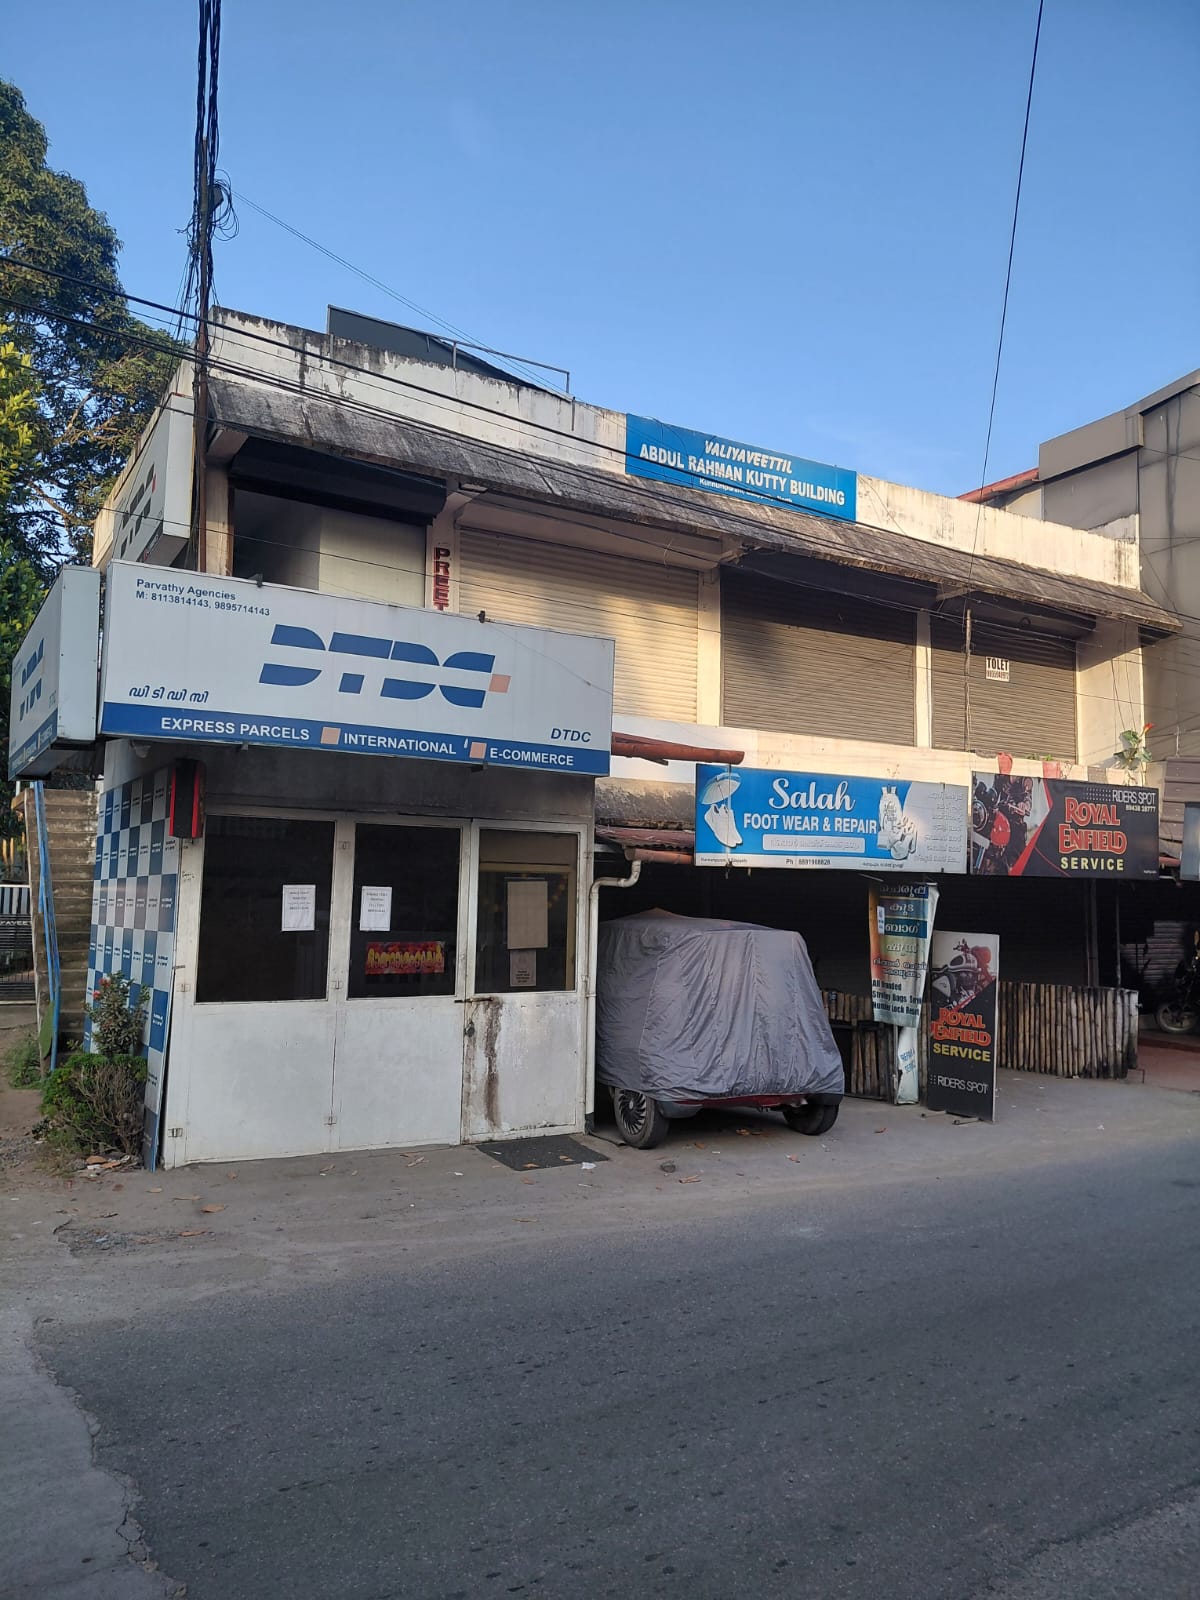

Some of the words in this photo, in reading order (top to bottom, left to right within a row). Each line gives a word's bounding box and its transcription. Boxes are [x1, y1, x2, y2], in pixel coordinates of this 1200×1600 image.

[705, 440, 792, 474] VALIYAVEETTIL
[639, 443, 684, 469] ABDUL
[688, 456, 742, 481] RAHMAN
[746, 469, 787, 492] KUTTY
[790, 479, 845, 506] BUILDING
[136, 578, 184, 594] Parvathy
[187, 586, 236, 600] Agencies
[136, 590, 149, 599] M:
[151, 593, 212, 609] 8113814143,
[214, 601, 270, 616] 9895714143
[258, 623, 497, 709] DTDC
[129, 685, 150, 697] ഡി
[152, 687, 165, 699] ടി
[167, 689, 187, 701] ഡി
[189, 691, 209, 703] സി
[161, 717, 235, 735] EXPRESS
[239, 723, 310, 740] PARCELS
[550, 728, 592, 743] DTDC
[344, 732, 456, 755] INTERNATIONAL
[490, 747, 574, 766] E-COMMERCE
[768, 778, 856, 811] Salah
[1112, 789, 1137, 804] RIDERS
[1138, 792, 1156, 805] SPOT
[1065, 797, 1120, 826] ROYAL
[743, 813, 779, 830] FOOT
[782, 816, 819, 832] WEAR
[822, 817, 830, 832] &
[834, 818, 878, 834] REPAIR
[1059, 824, 1127, 855] ENFIELD
[1060, 857, 1124, 871] SERVICE
[939, 1007, 986, 1029] ROYAL
[930, 1021, 991, 1047] ENFIELD
[933, 1042, 991, 1062] SERVICE
[938, 1075, 965, 1090] RIDERS
[966, 1080, 988, 1094] SPOT
